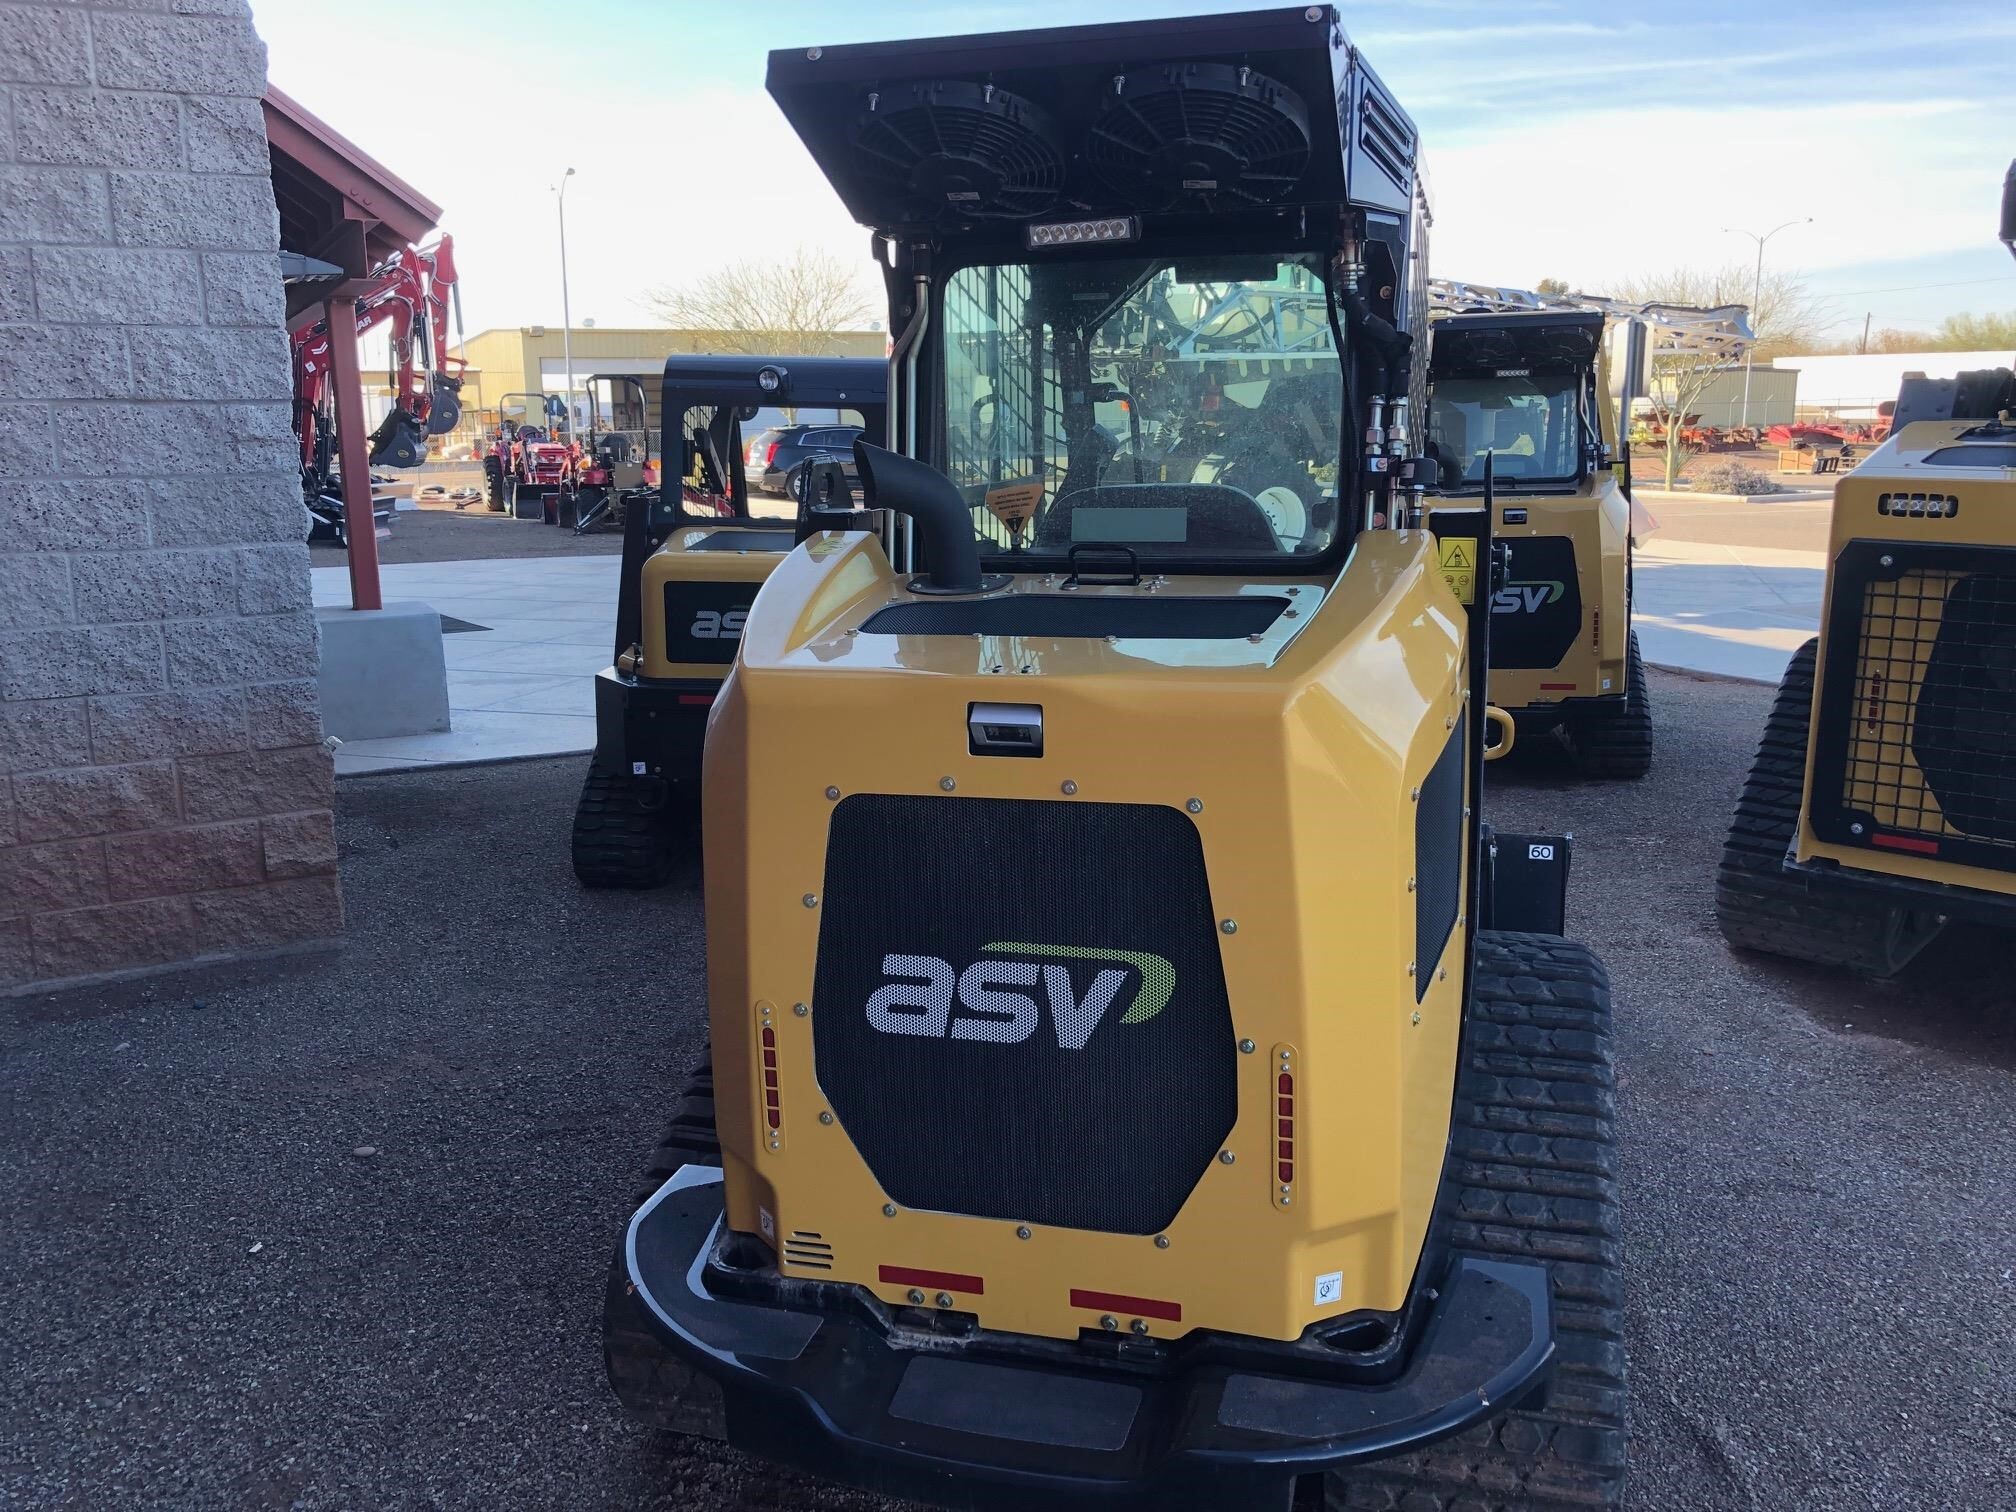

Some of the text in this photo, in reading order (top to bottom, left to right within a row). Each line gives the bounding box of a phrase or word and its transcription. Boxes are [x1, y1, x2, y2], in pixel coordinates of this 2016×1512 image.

[1489, 586, 1550, 614] sv
[690, 610, 749, 639] as
[1531, 846, 1551, 859] 60
[865, 953, 1129, 1050] asv
